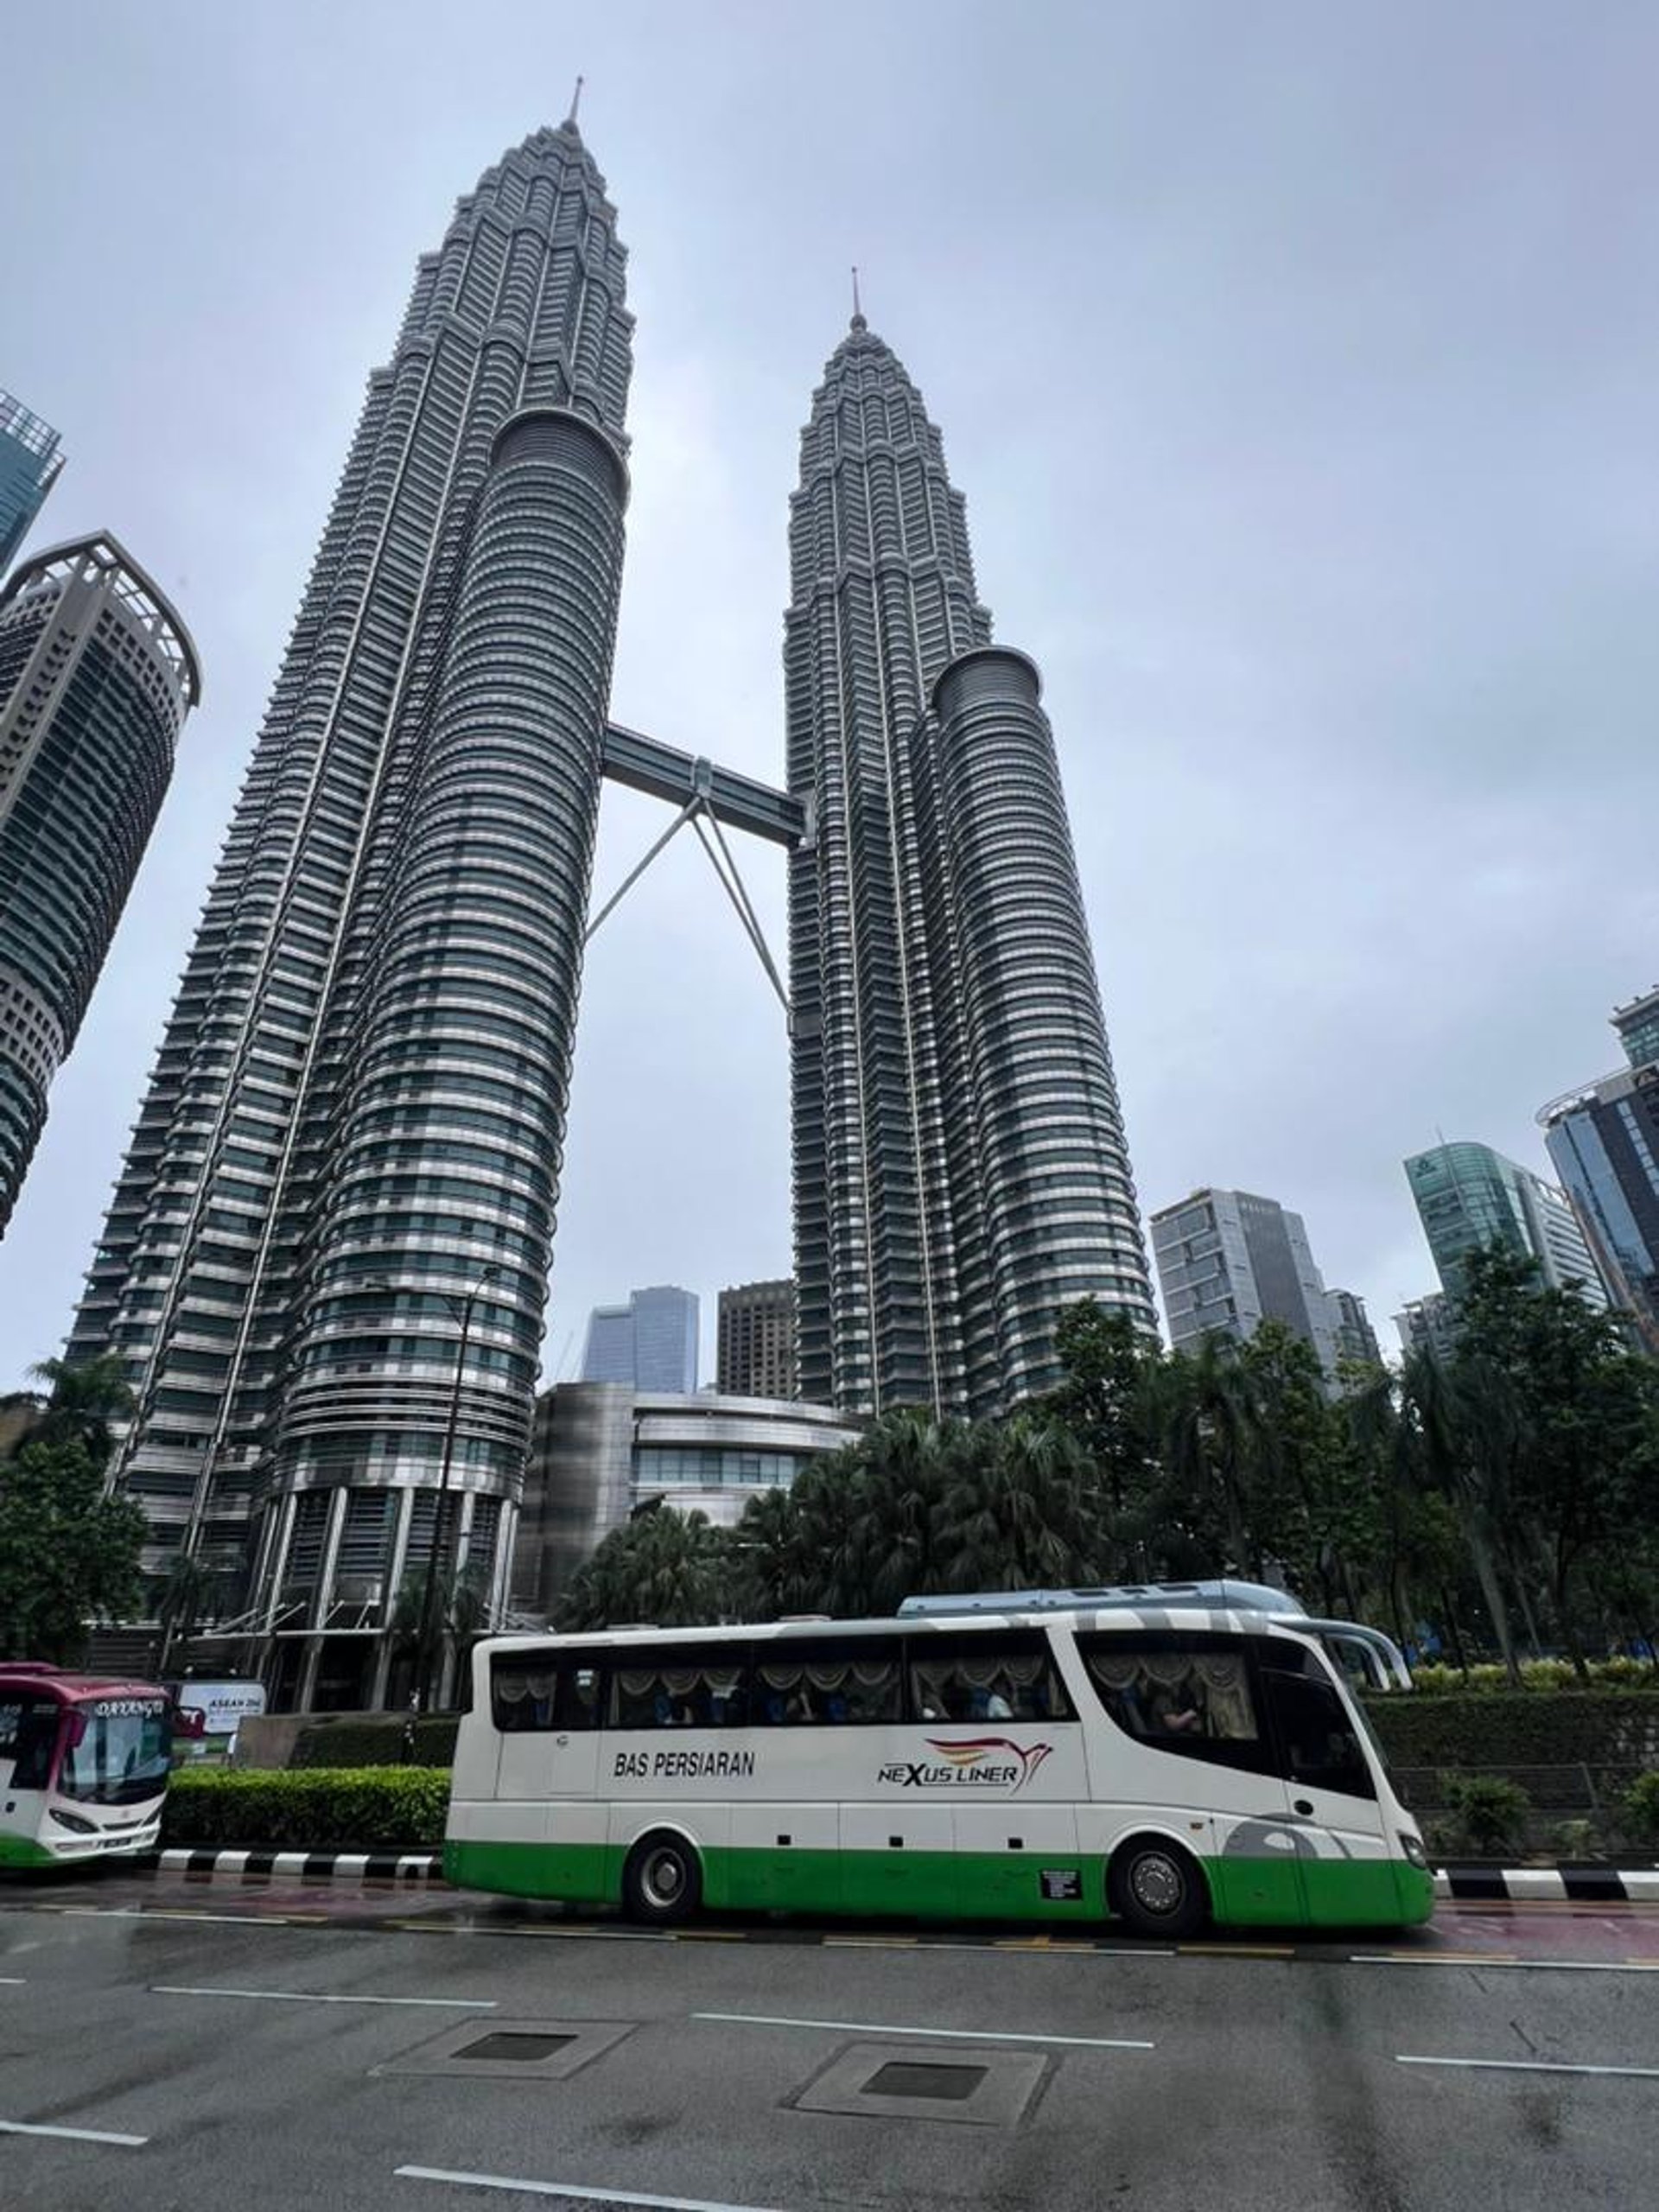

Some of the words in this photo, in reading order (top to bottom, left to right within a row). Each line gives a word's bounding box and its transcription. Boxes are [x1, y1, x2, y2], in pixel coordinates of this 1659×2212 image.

[614, 1752, 648, 1777] BAS
[653, 1752, 754, 1777] PERSIARAN
[878, 1764, 951, 1786] NEXUS
[957, 1767, 1017, 1783] LINER
